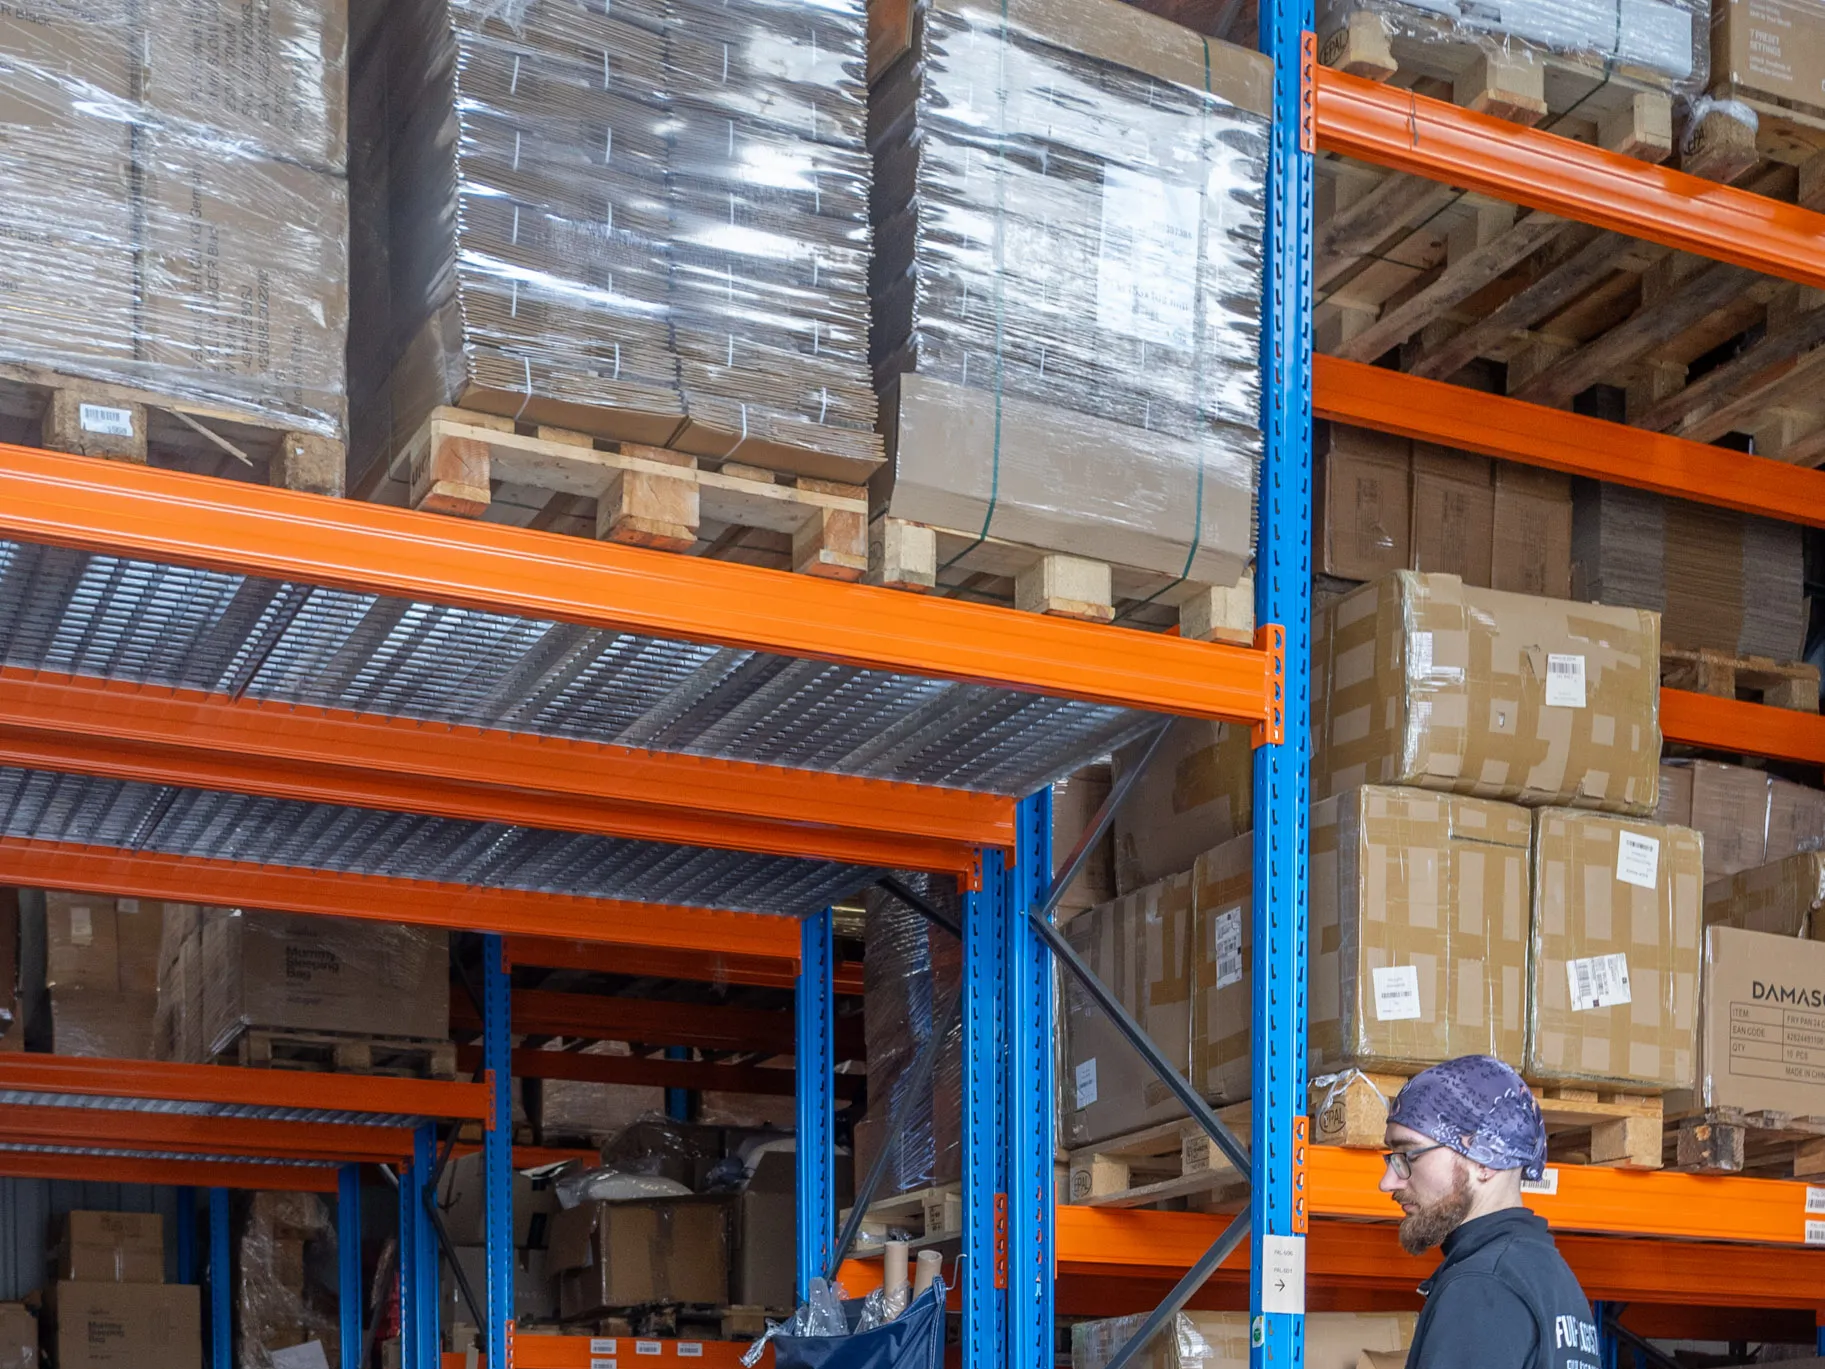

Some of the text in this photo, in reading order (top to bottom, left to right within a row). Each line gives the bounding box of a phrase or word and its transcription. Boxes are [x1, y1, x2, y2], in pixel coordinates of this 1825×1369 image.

[1751, 980, 1825, 1009] DAMAS
[1732, 1008, 1749, 1018] ITEM
[1732, 1043, 1746, 1052] QTY
